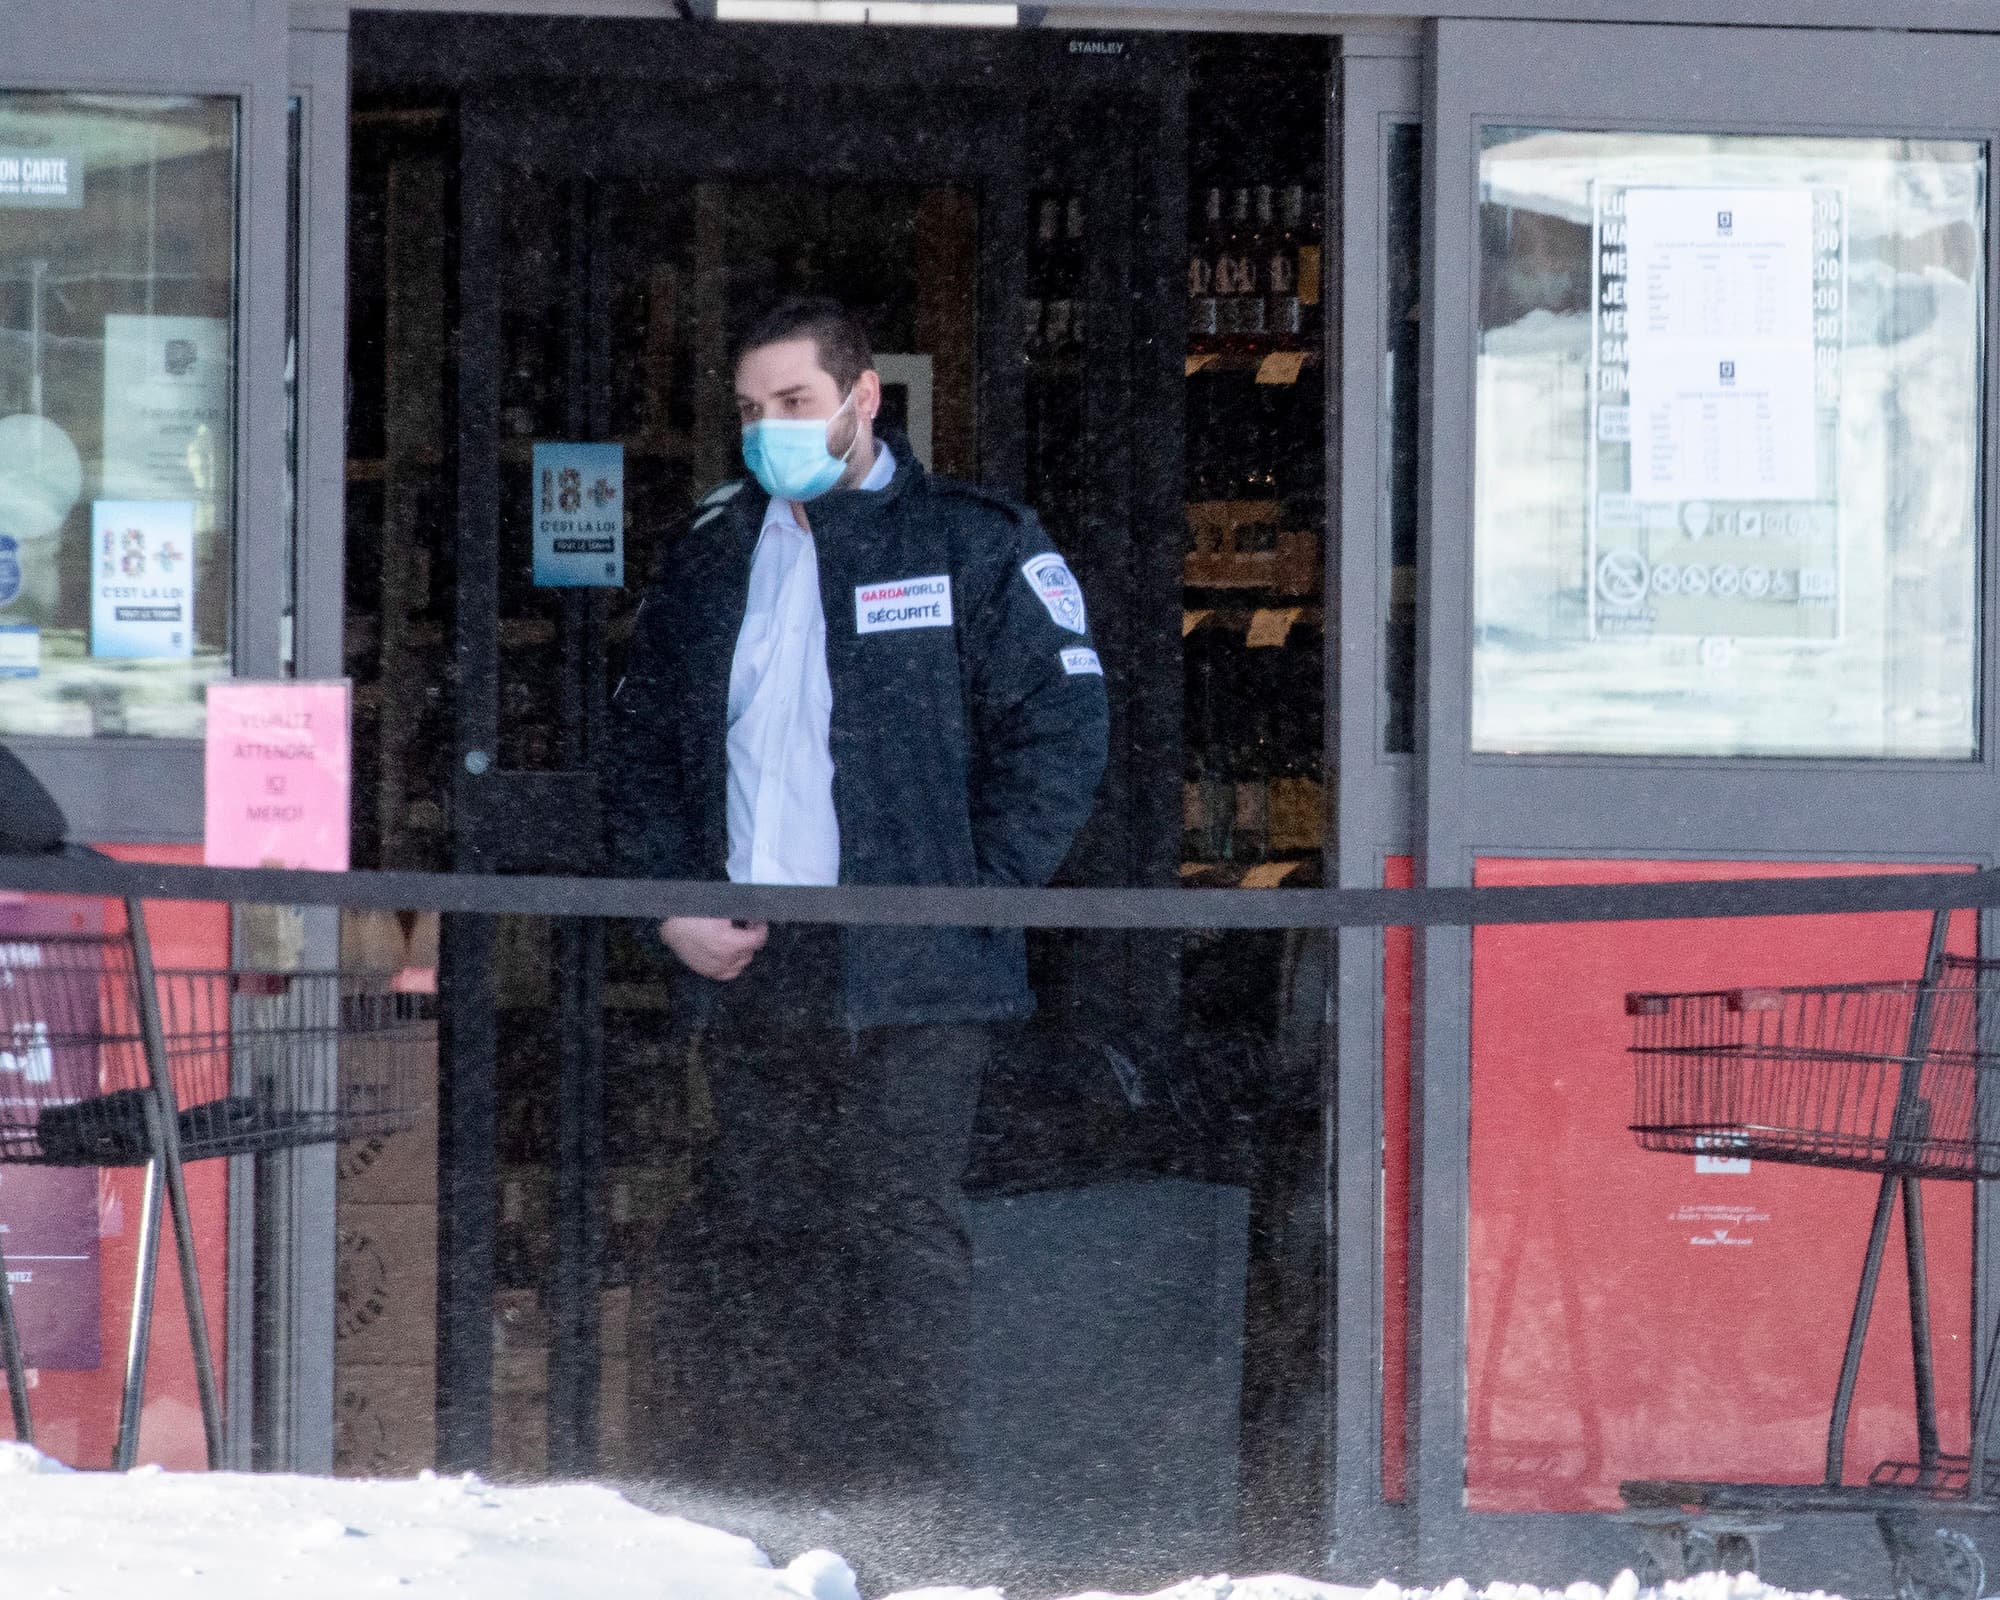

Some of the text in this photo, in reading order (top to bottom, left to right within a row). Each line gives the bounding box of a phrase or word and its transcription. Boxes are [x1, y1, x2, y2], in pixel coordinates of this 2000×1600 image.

[1069, 40, 1124, 54] STANLEY
[22, 158, 67, 183] CARTE
[540, 466, 617, 514] 18+
[577, 520, 593, 533] LA
[596, 520, 616, 533] LOI
[101, 586, 184, 599] C'EST LA LOI
[861, 582, 945, 602] GARDAWORLD
[867, 601, 941, 623] SÉCURITÉ
[233, 743, 316, 760] ATTENDRE
